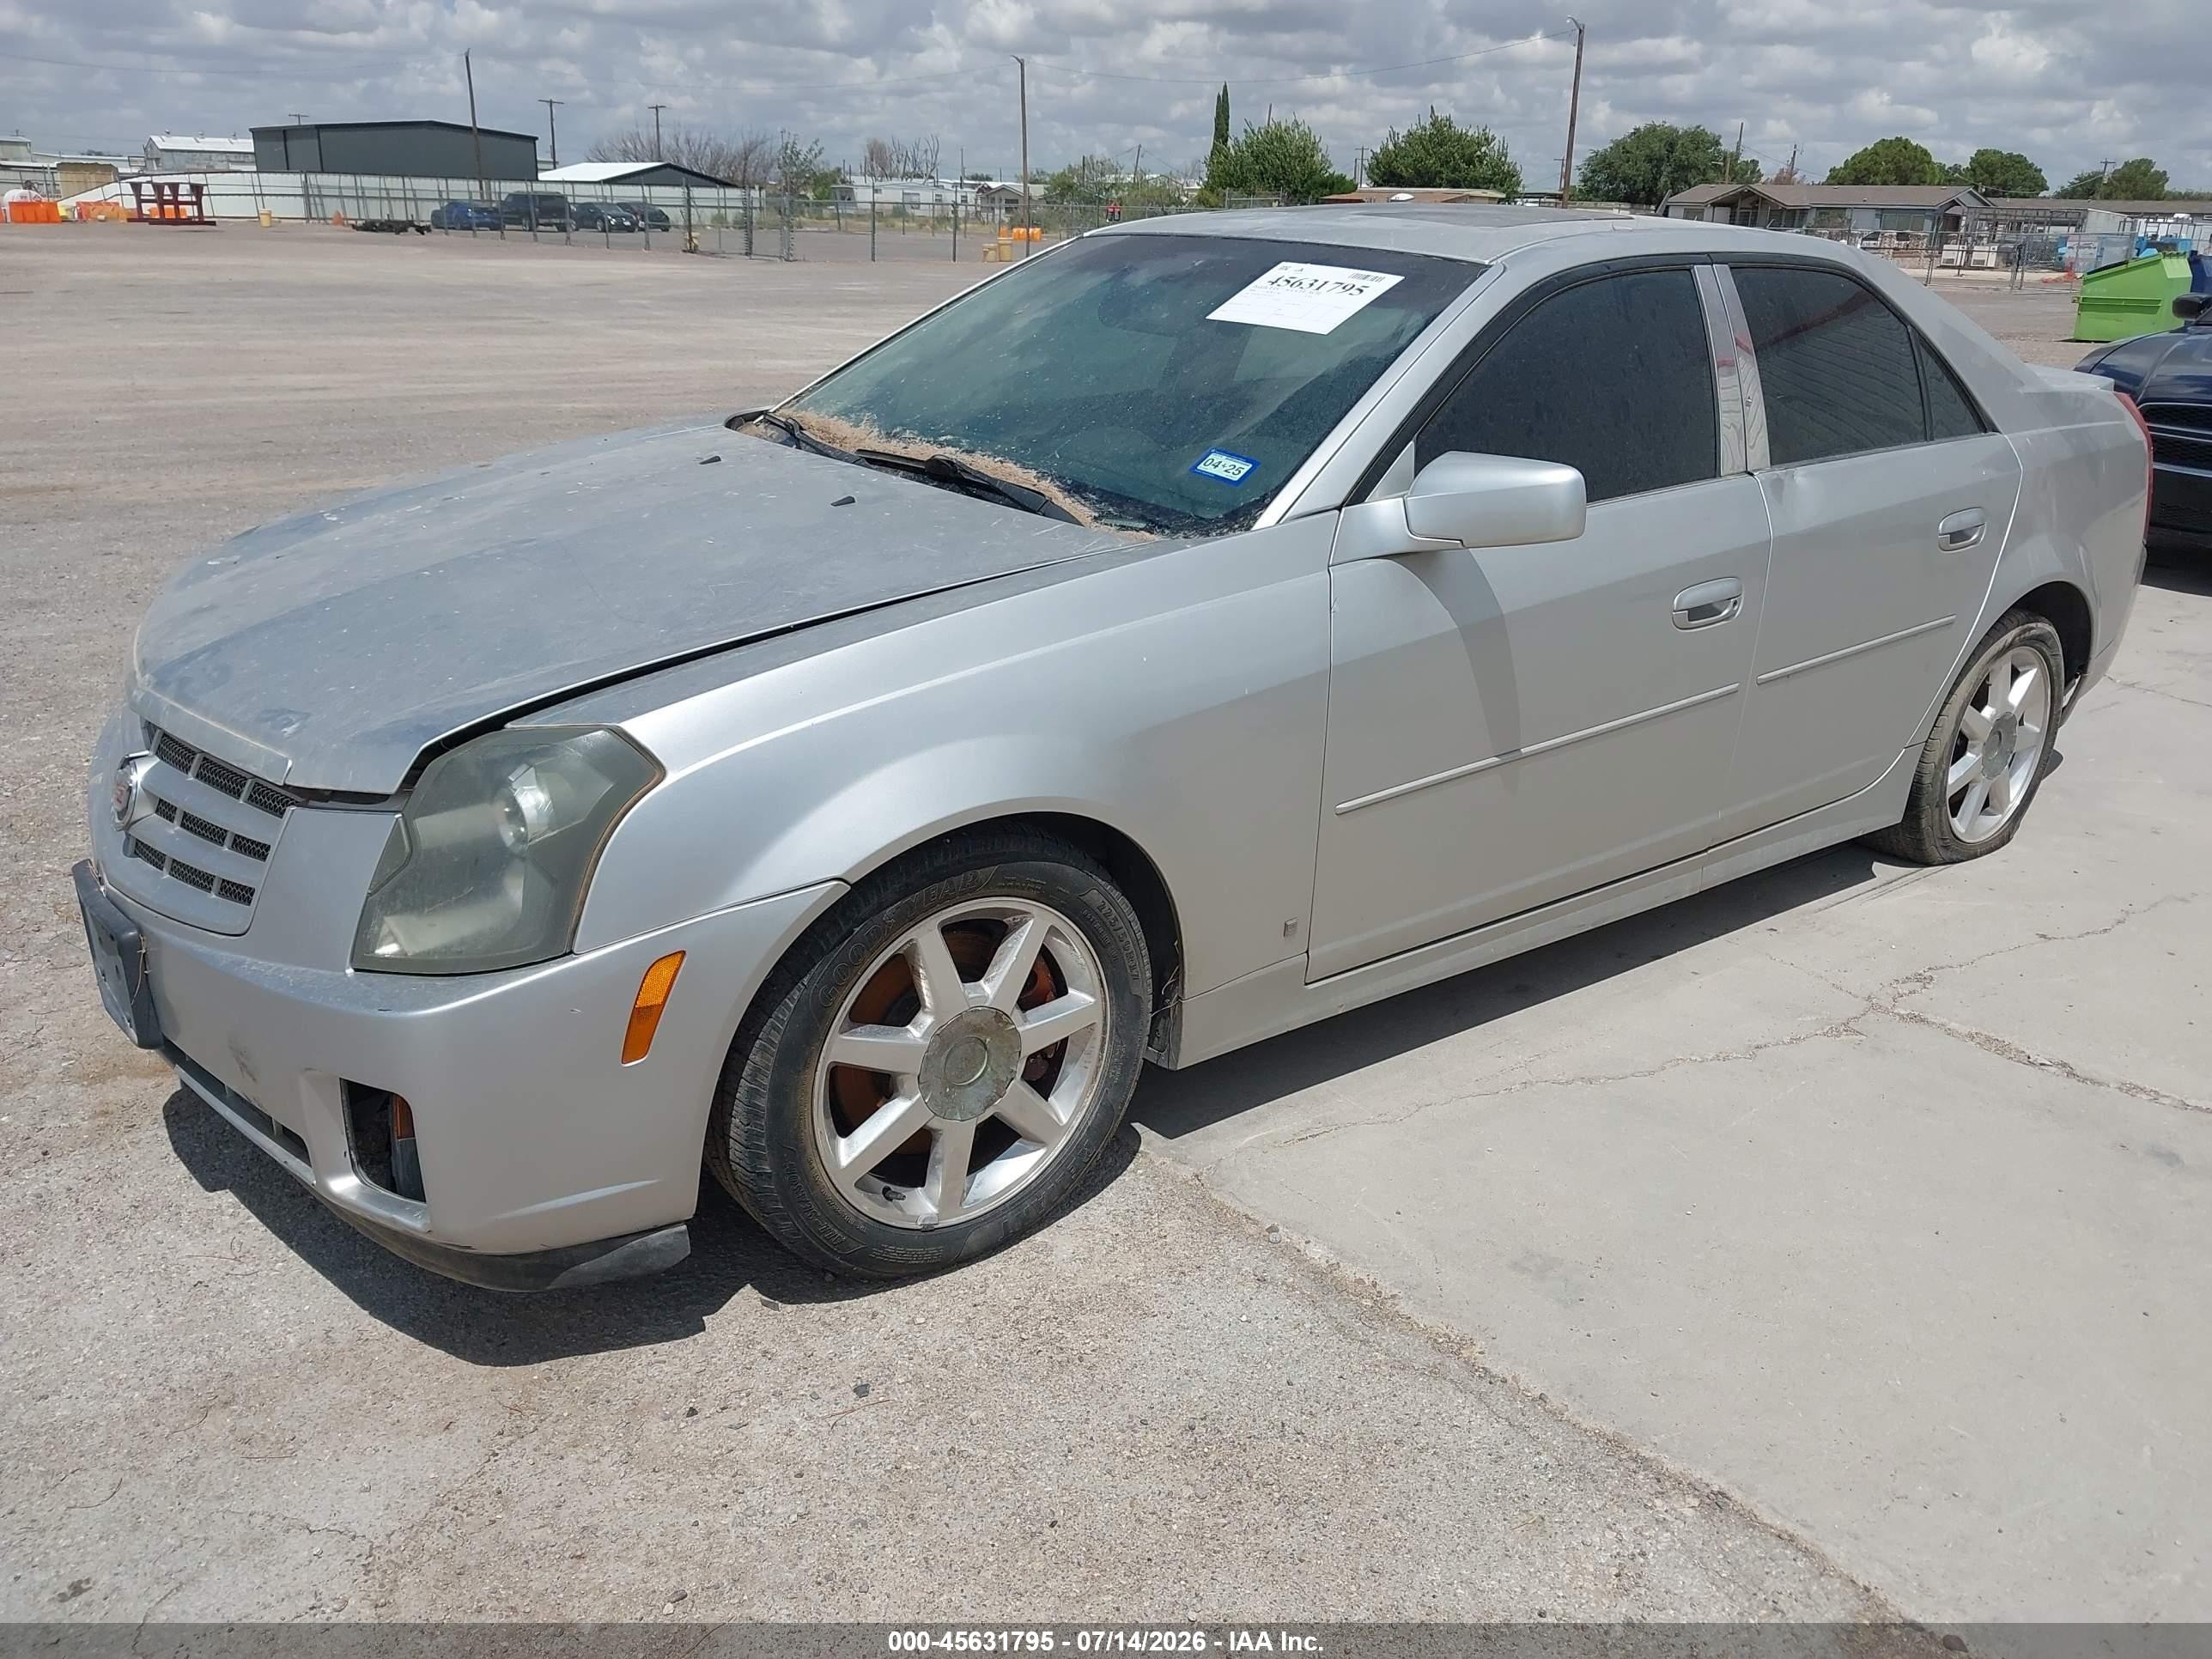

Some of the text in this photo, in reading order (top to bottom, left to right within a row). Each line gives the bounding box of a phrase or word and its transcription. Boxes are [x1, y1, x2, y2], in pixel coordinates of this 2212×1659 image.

[1267, 275, 1370, 296] 45631795
[1203, 458, 1245, 476] 04 25
[818, 869, 981, 1007] GOODYEAR
